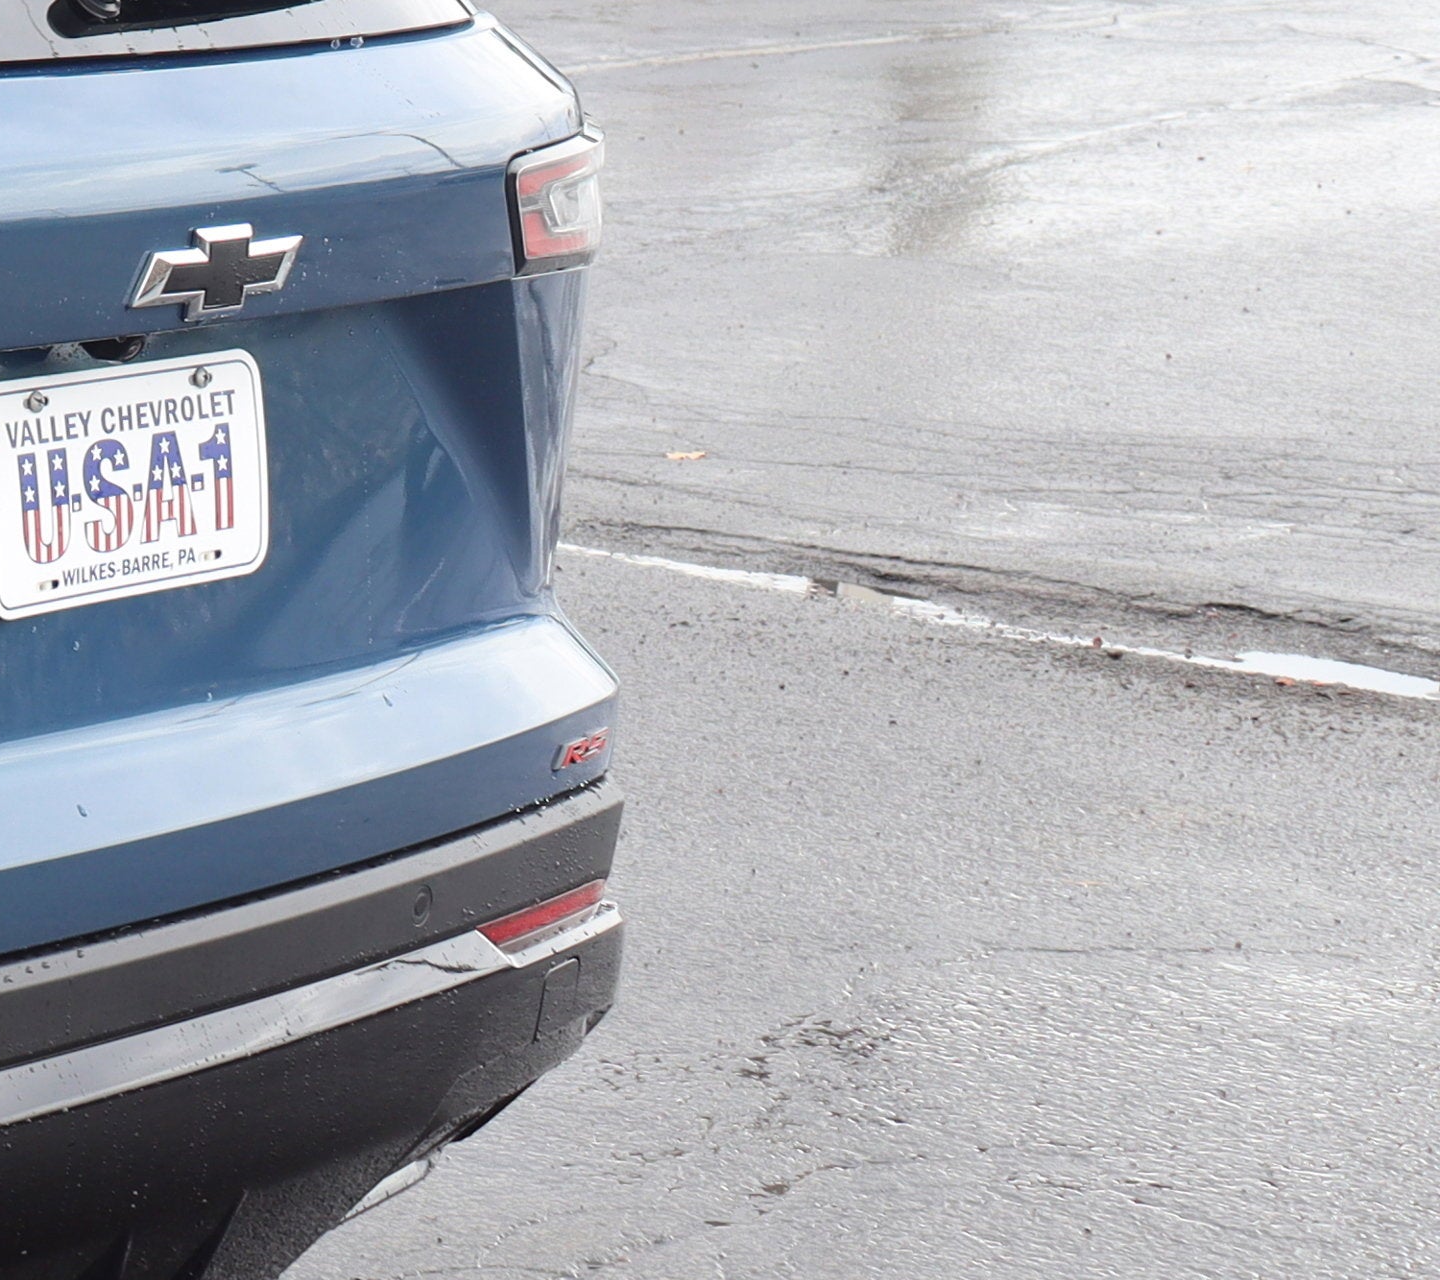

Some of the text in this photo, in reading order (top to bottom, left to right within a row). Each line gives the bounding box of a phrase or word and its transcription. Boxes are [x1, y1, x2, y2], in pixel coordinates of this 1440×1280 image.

[5, 389, 235, 448] VALLEY CHEVROLET
[62, 547, 196, 587] WILKES-BARRE, PA
[551, 726, 610, 773] RS
